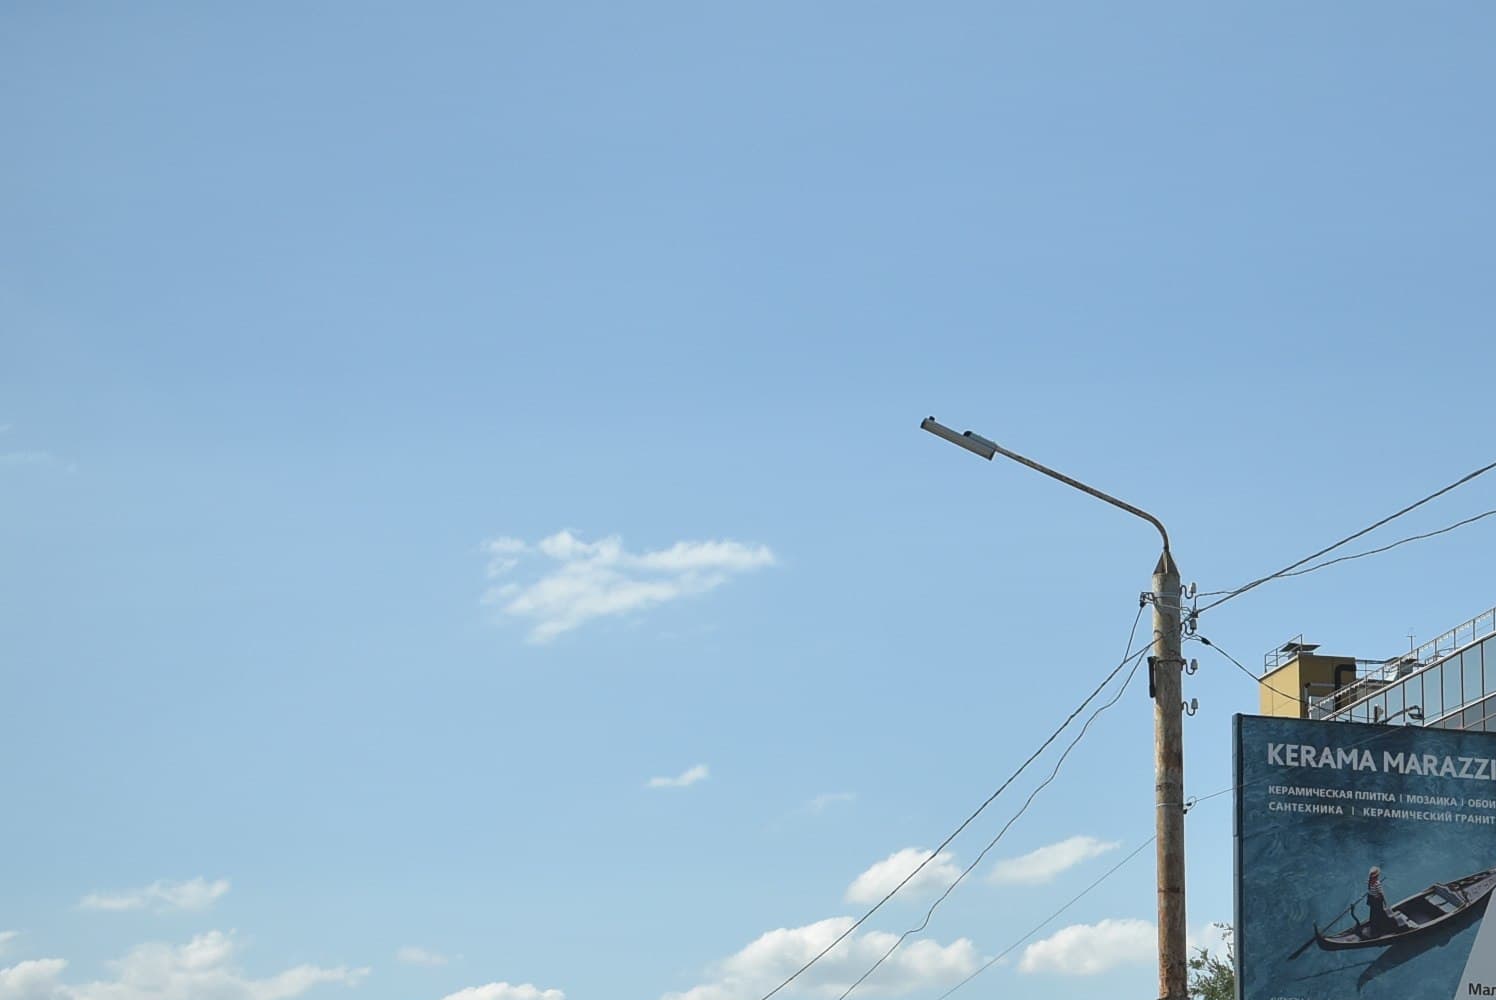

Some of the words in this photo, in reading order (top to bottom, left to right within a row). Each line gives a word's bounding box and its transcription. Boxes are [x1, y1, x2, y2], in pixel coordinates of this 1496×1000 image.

[1267, 743, 1377, 772] KERAMA
[1383, 751, 1496, 781] MARAZZI
[1268, 785, 1353, 800] КЕРАМИЧЕСКАЯ
[1354, 791, 1396, 803] ПЛИТКА
[1406, 794, 1458, 807] МОЗАИКА
[1467, 798, 1496, 809] ОБОИ
[1268, 801, 1344, 815] САНТЕХНИКА
[1363, 807, 1452, 822] КЕРАМИЧЕСКИЙ
[1455, 813, 1496, 825] ГРАНИТ
